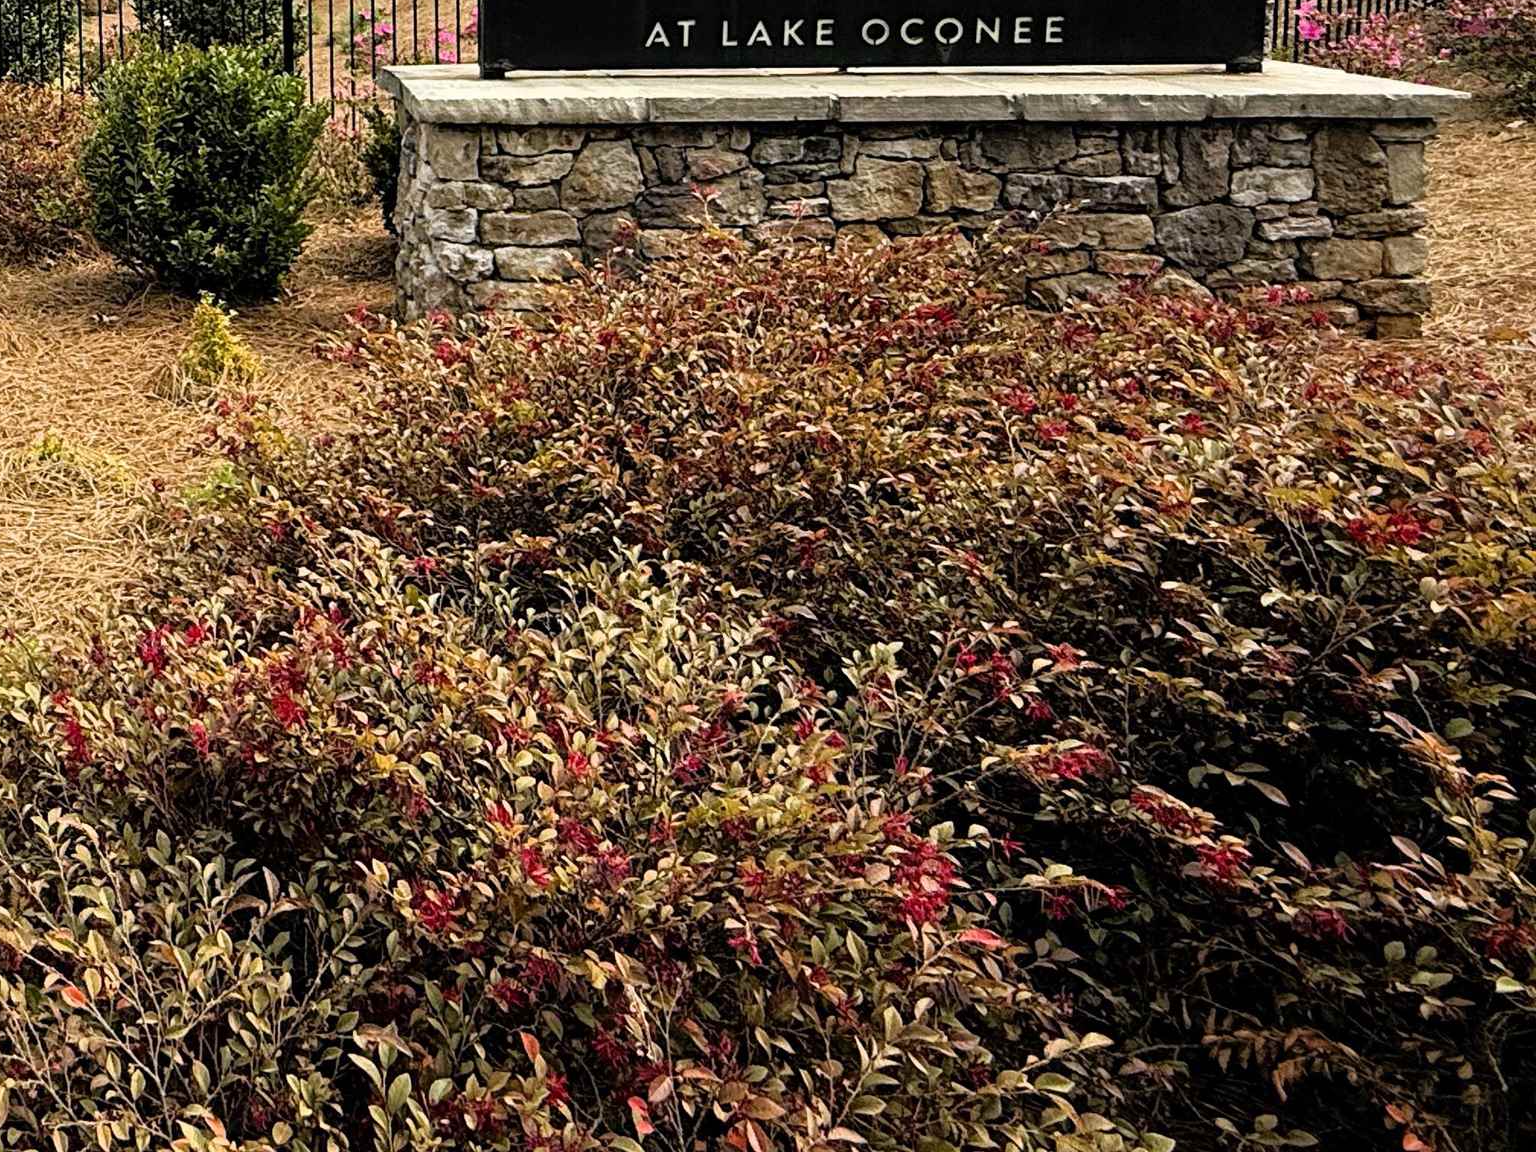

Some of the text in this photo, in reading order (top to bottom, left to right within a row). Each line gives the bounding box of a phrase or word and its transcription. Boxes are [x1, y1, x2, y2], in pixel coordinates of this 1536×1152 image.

[645, 16, 1065, 48] AT LAKE OCONEE
